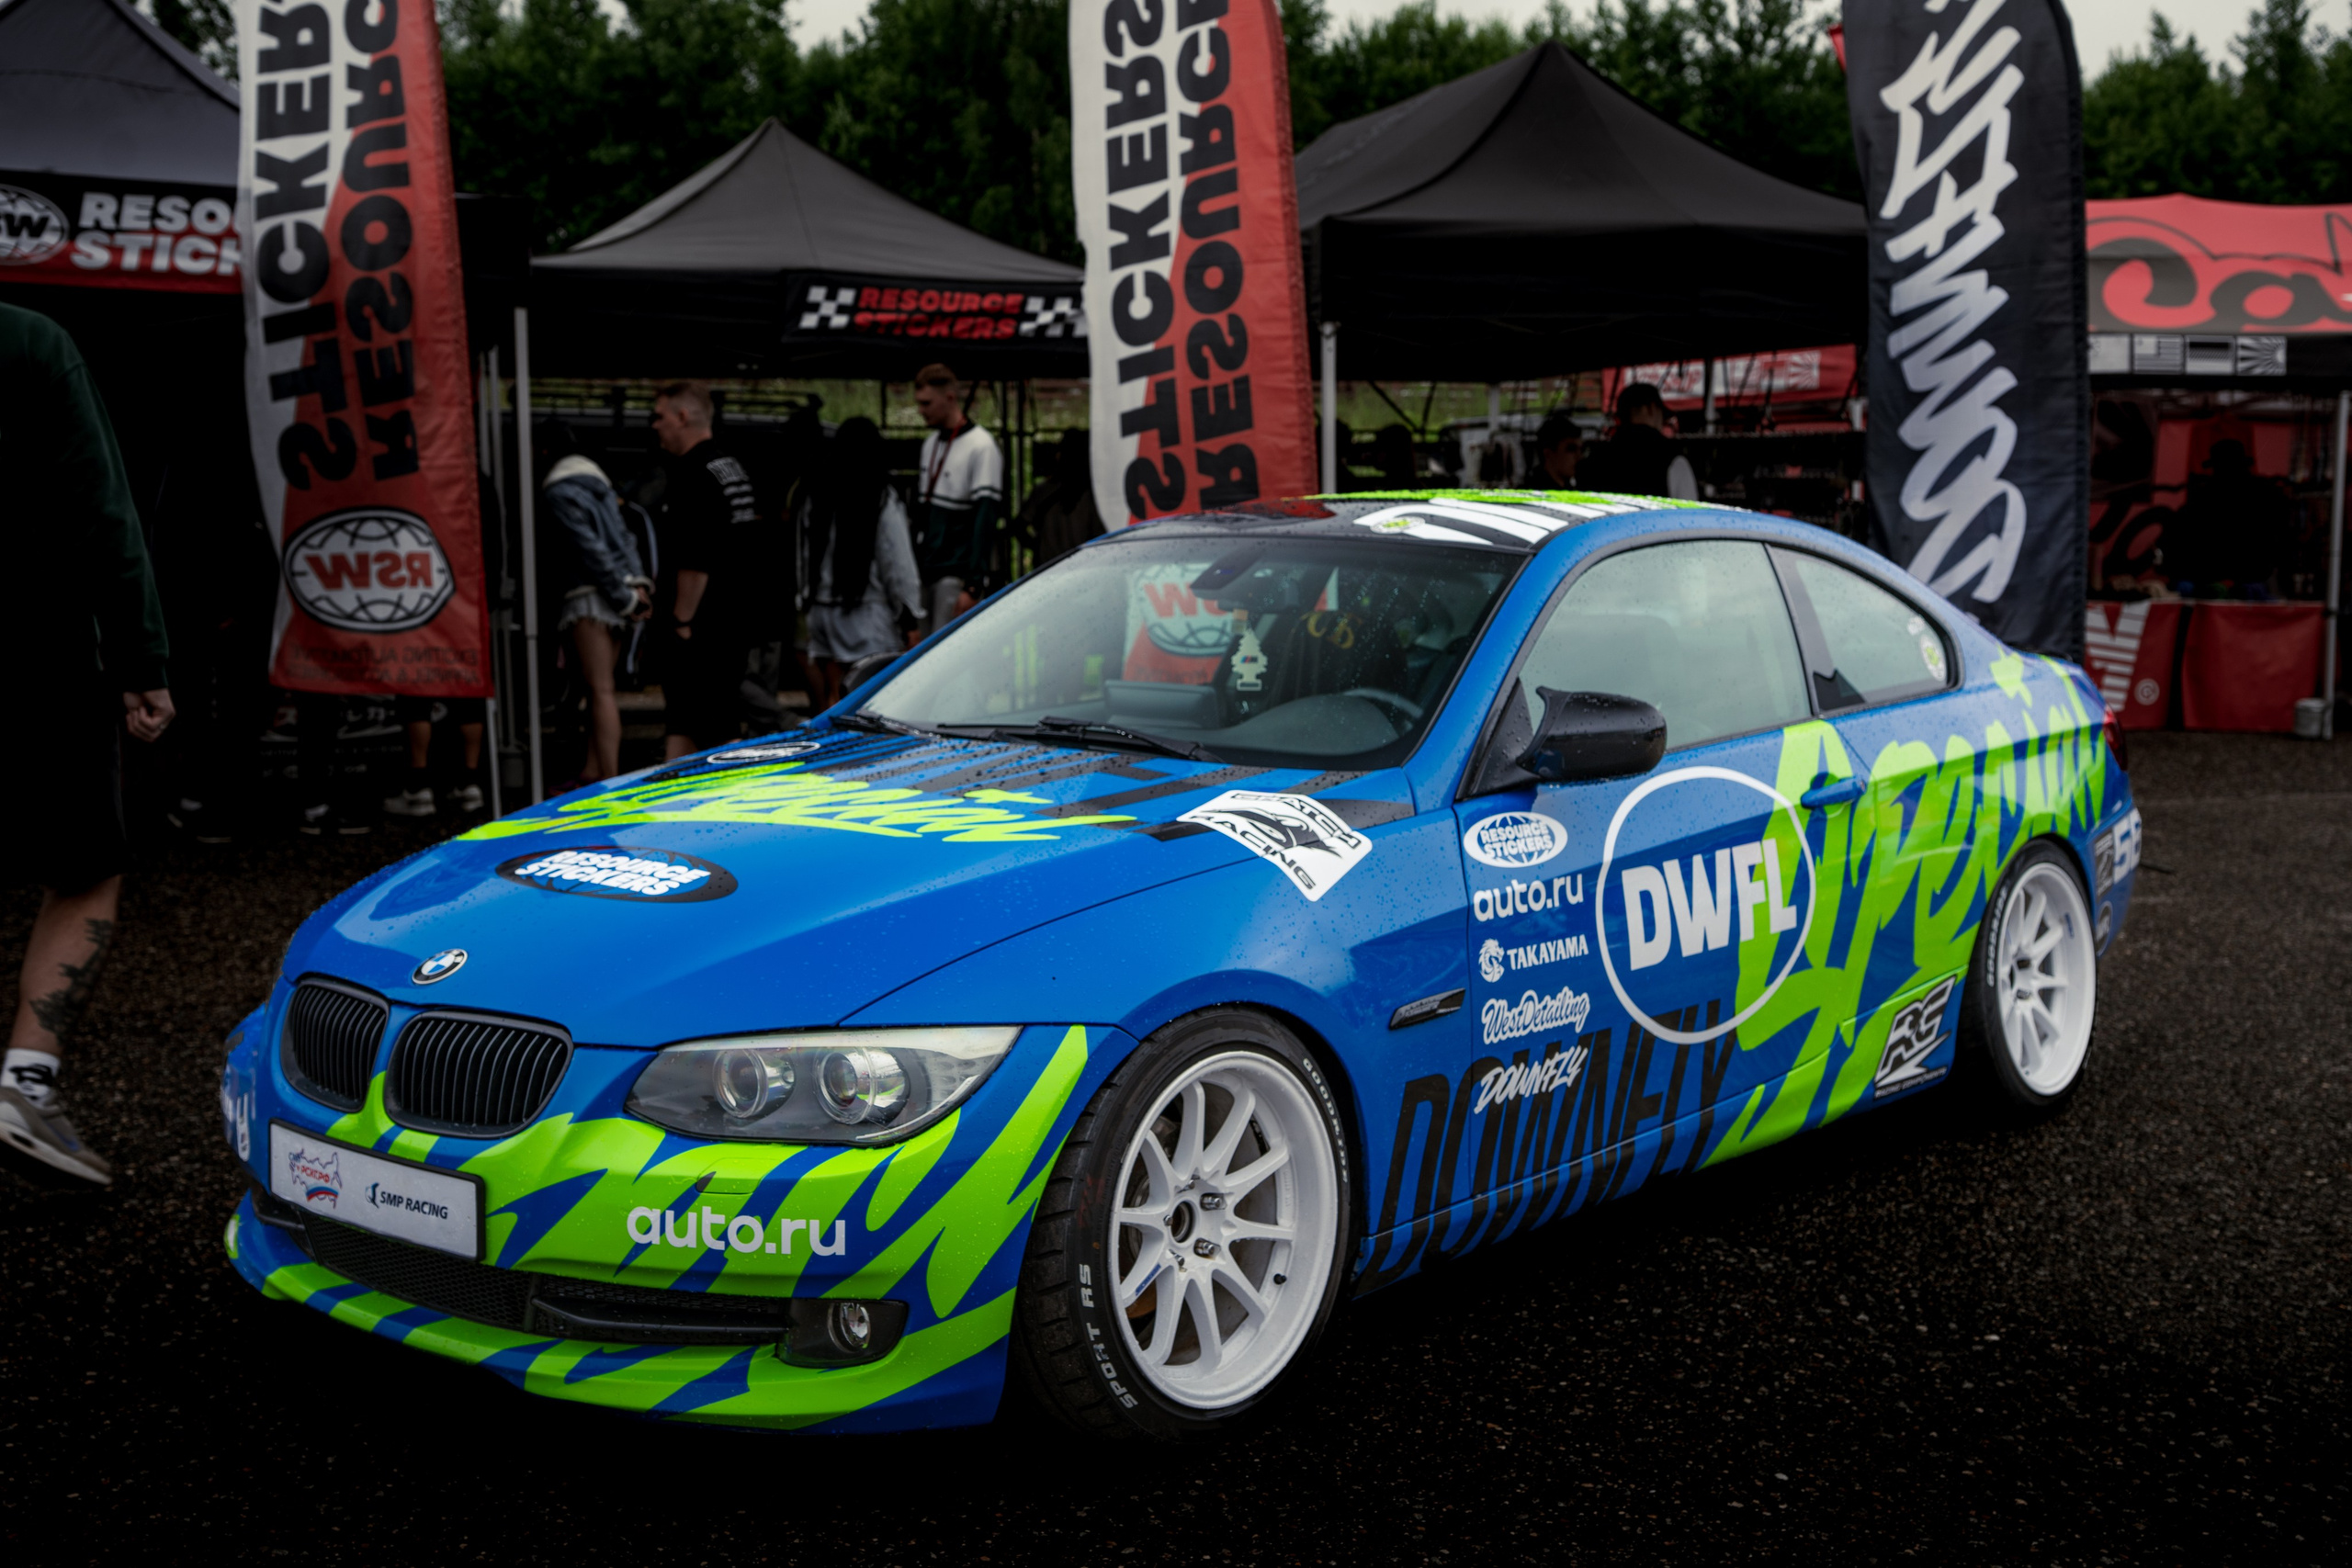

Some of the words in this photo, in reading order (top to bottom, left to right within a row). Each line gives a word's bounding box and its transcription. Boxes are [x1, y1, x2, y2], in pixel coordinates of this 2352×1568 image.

[77, 190, 240, 237] RESO
[856, 285, 1025, 315] RESOURCE
[853, 310, 1018, 340] STICKERS
[1479, 821, 1549, 844] RESOURCE
[1484, 834, 1554, 859] STICKERS
[542, 850, 712, 885] RESOURCE
[1189, 815, 1317, 890] RACING
[514, 861, 681, 896] STICKERS
[1473, 873, 1584, 922] auto.ru
[1621, 837, 1798, 971] DWFL
[1506, 933, 1589, 971] TAKAYAMA
[379, 1190, 404, 1208] SMP
[405, 1198, 449, 1220] RACING
[626, 1205, 846, 1257] auto.ru
[1079, 1263, 1095, 1309] RS
